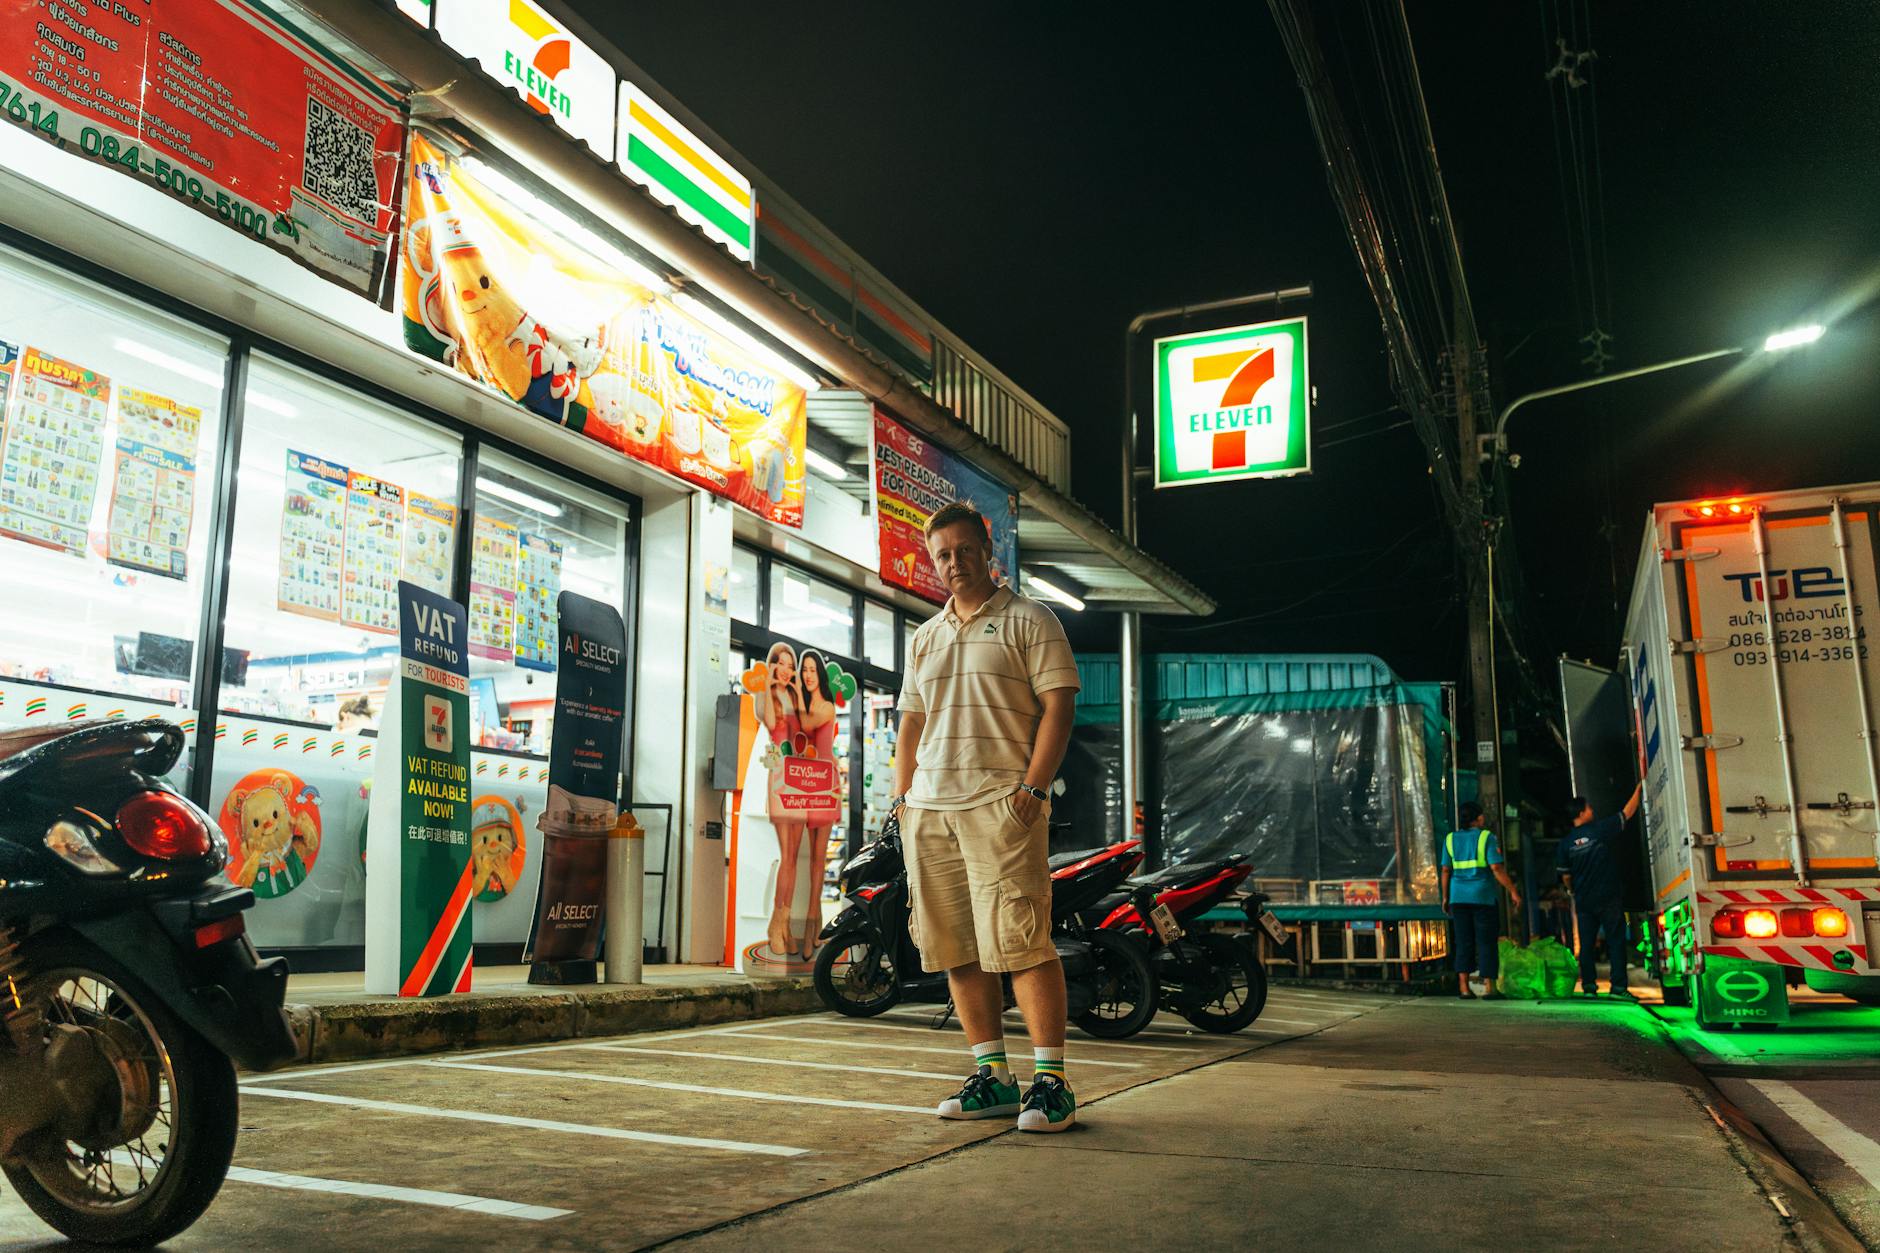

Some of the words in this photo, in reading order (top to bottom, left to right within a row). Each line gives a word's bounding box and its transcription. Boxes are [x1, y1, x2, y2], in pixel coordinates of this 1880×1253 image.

[113, 2, 141, 26] Plus
[36, 21, 86, 62] คุณสมบัติ
[57, 54, 67, 66] 18
[77, 65, 91, 78] 50
[79, 125, 269, 242] 084-509-5100
[1193, 347, 1275, 470] 7
[876, 441, 904, 472] BEST
[904, 459, 956, 502] READY-SIM
[882, 470, 906, 497] FOR
[411, 600, 456, 644] VAT
[414, 637, 459, 664] REFUND
[582, 640, 620, 666] SELECT
[407, 663, 423, 677] FOR
[425, 667, 465, 691] TOURISTS
[407, 755, 428, 775] VAT
[430, 760, 467, 782] REFUND
[407, 778, 468, 803] AVAILABLE
[423, 800, 454, 820] NOW!
[563, 904, 598, 920] SELECT
[1723, 1008, 1767, 1016] HINO
